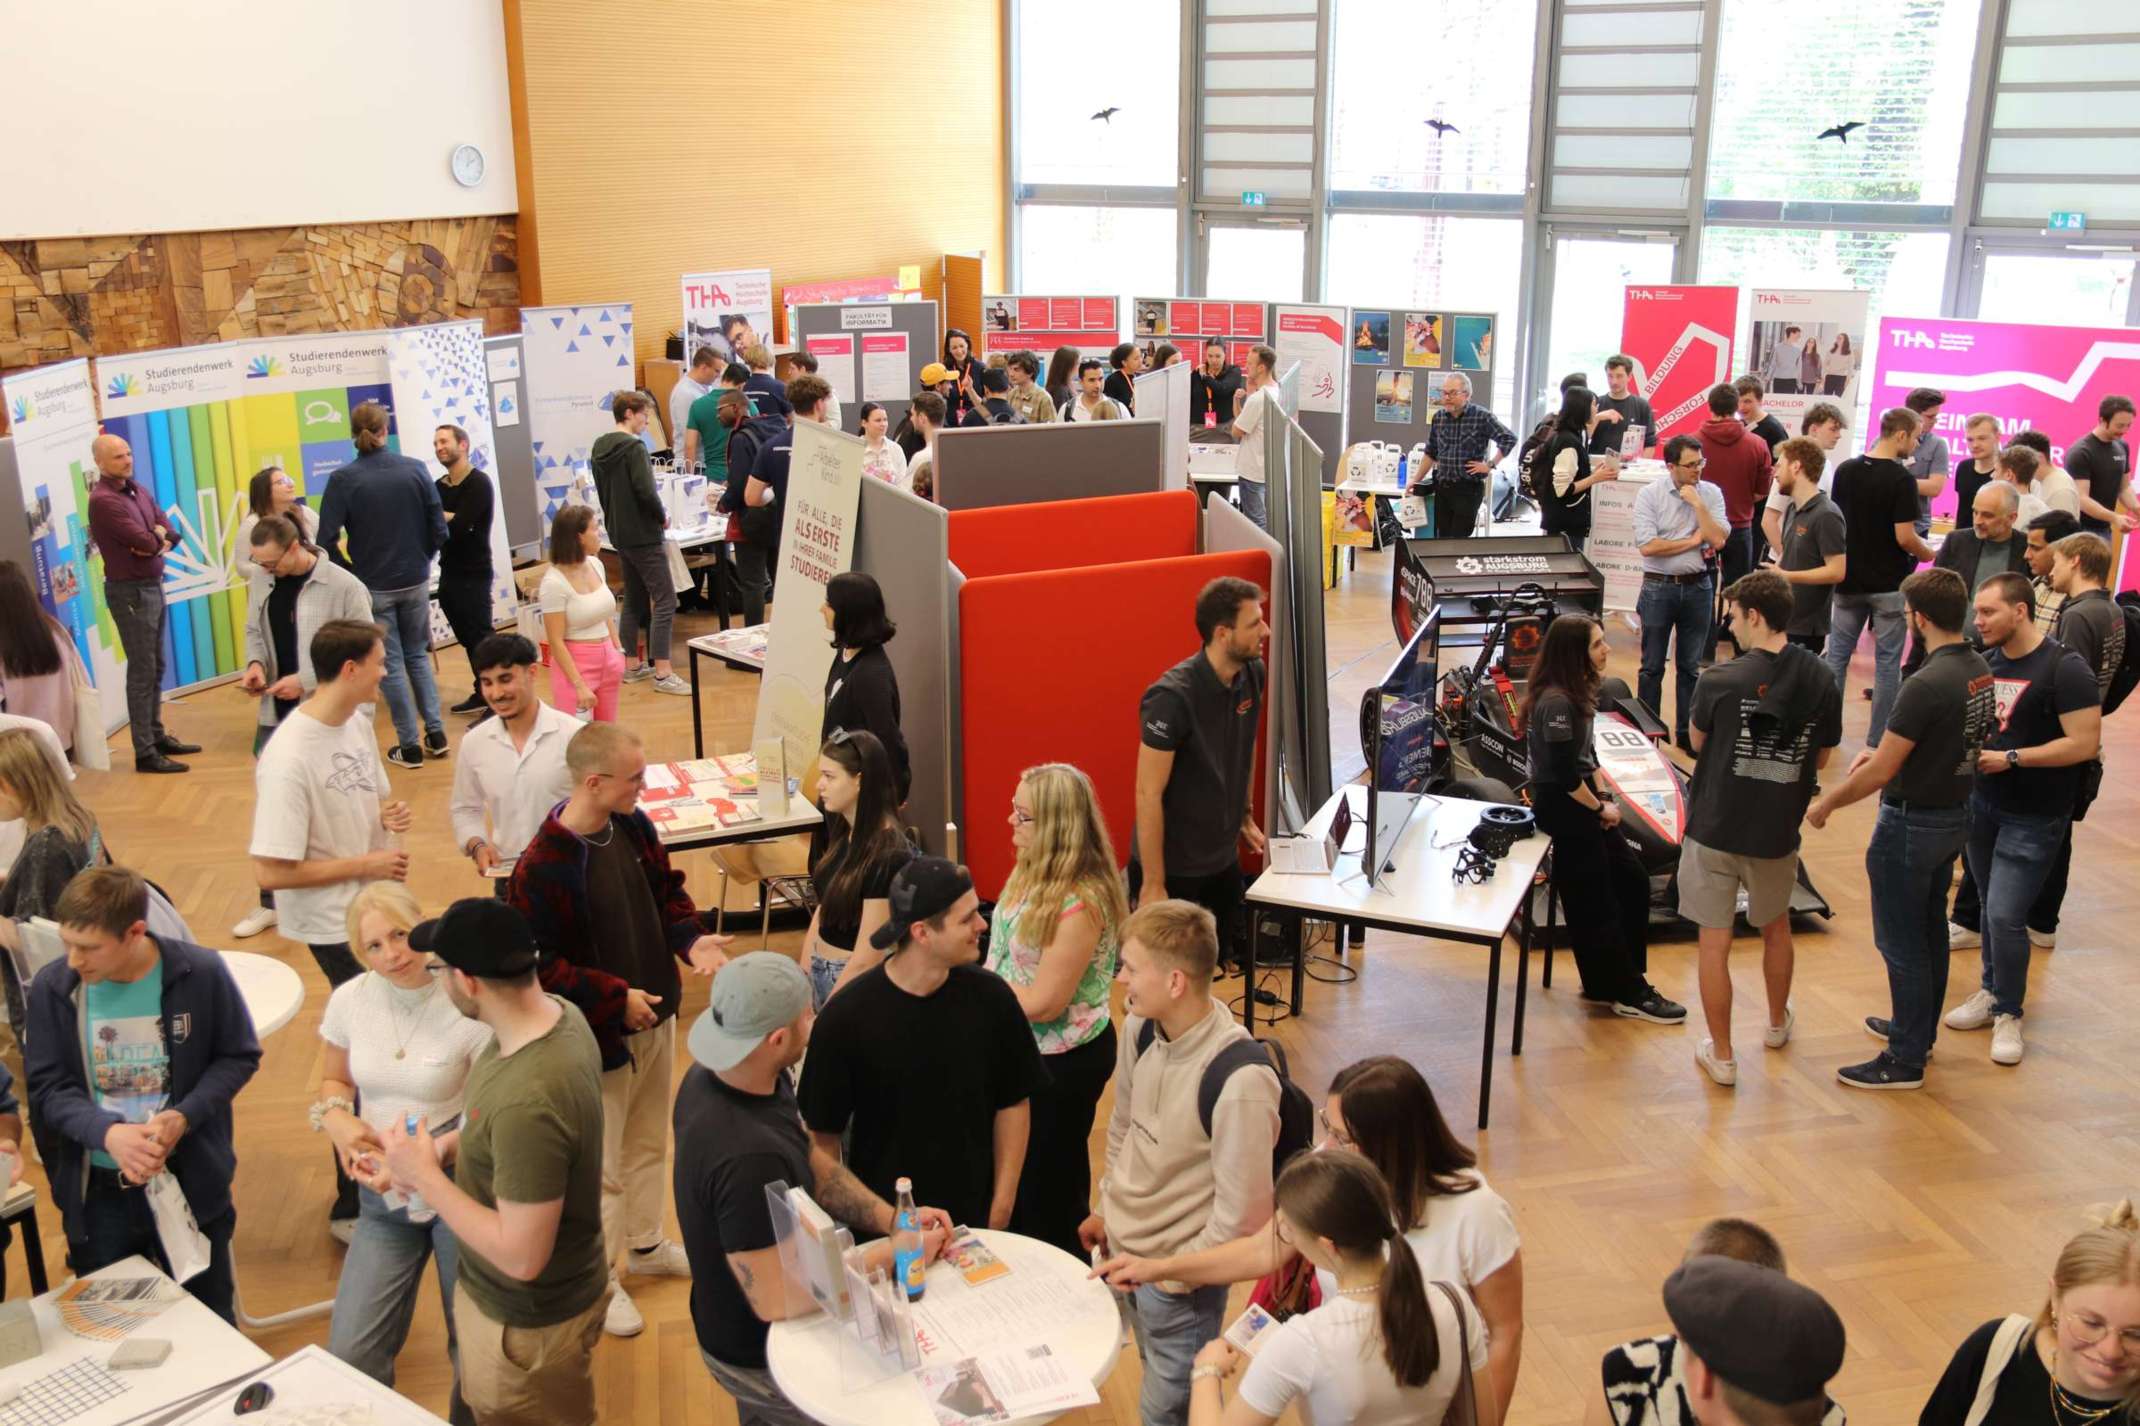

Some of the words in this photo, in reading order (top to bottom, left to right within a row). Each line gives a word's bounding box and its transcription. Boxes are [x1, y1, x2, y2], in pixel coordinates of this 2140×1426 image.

[289, 346, 388, 362] Studierendenwerk
[145, 359, 234, 380] Studierendenwerk
[291, 363, 343, 377] Augsburg
[1644, 345, 1683, 394] BILDUNG
[147, 378, 195, 394] Augsburg
[794, 518, 811, 540] ALS
[812, 523, 841, 553] ERSTE
[1483, 555, 1547, 564] starkstrom
[1486, 562, 1550, 570] AUGSBURG
